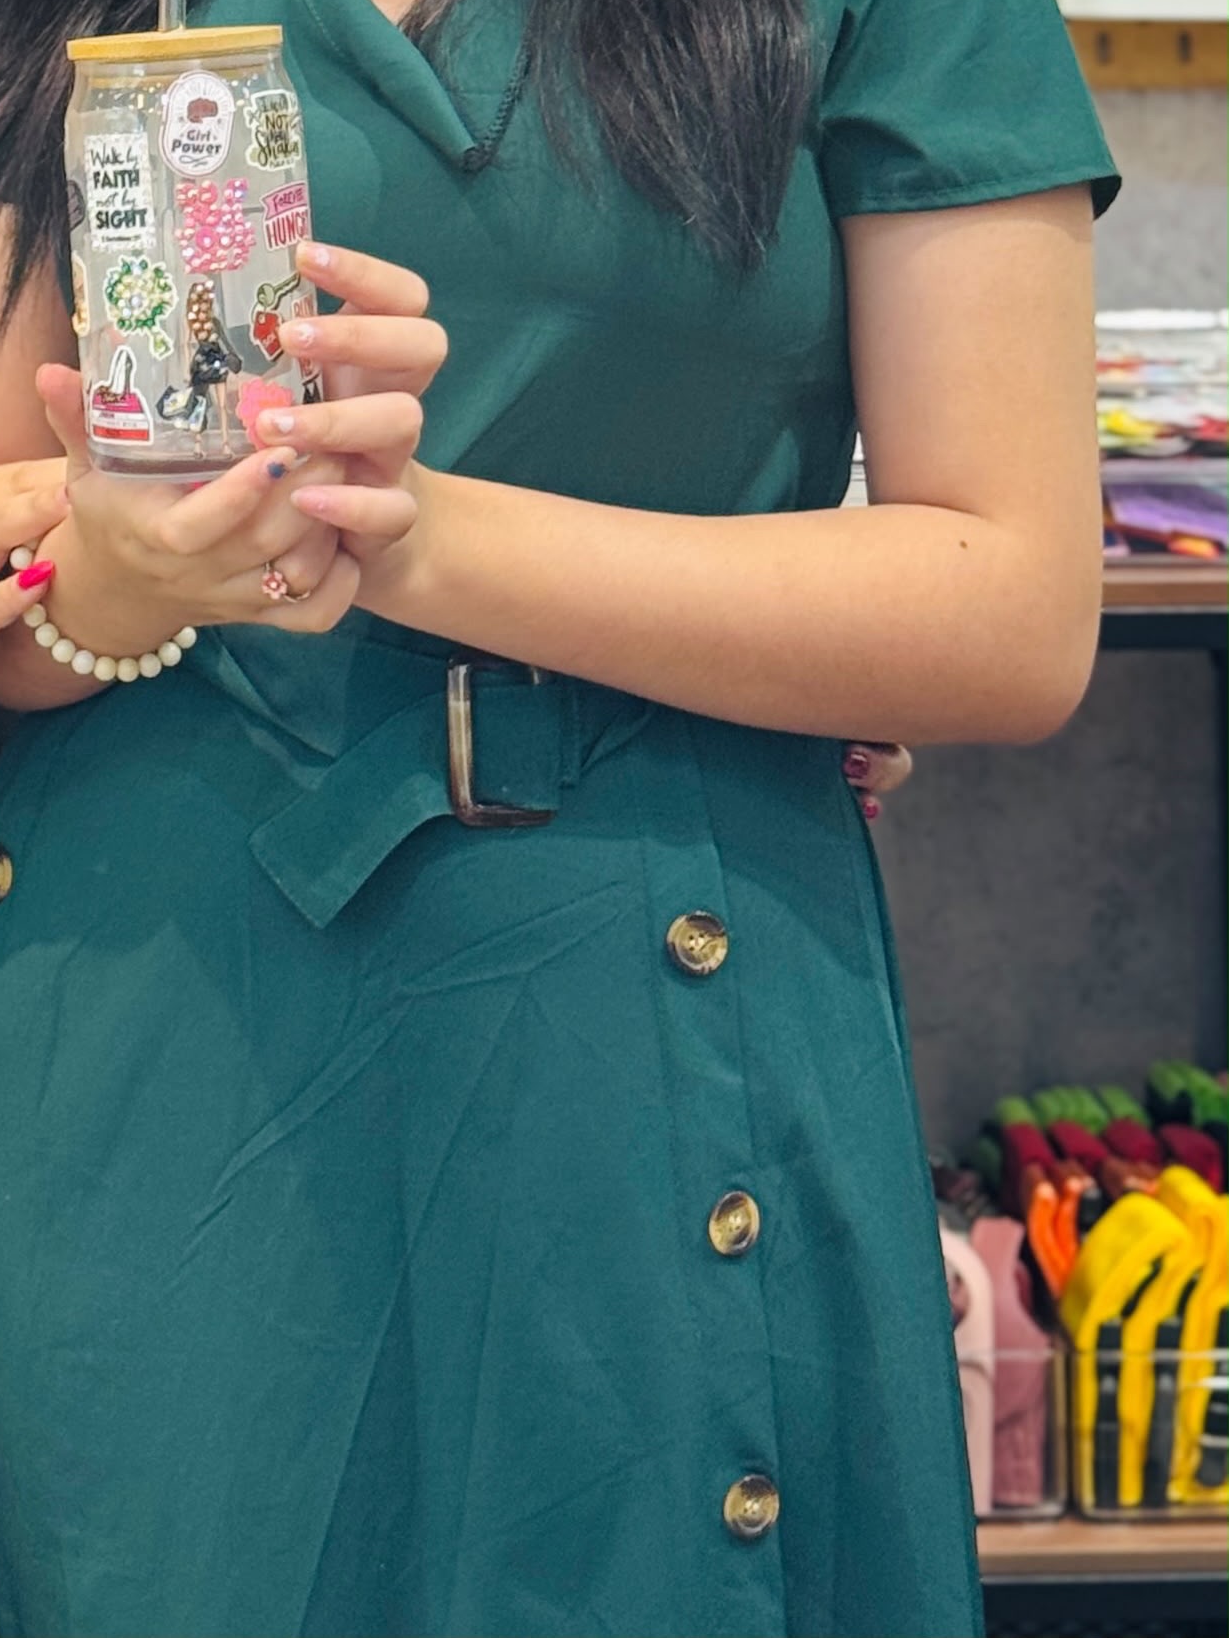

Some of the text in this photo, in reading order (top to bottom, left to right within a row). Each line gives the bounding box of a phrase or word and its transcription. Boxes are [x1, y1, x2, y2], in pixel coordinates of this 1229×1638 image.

[264, 113, 290, 130] NOT
[186, 129, 211, 141] Girl
[171, 138, 222, 154] Power
[93, 168, 140, 190] FAITH
[95, 207, 148, 230] SIGHT
[265, 209, 309, 249] HUNG
